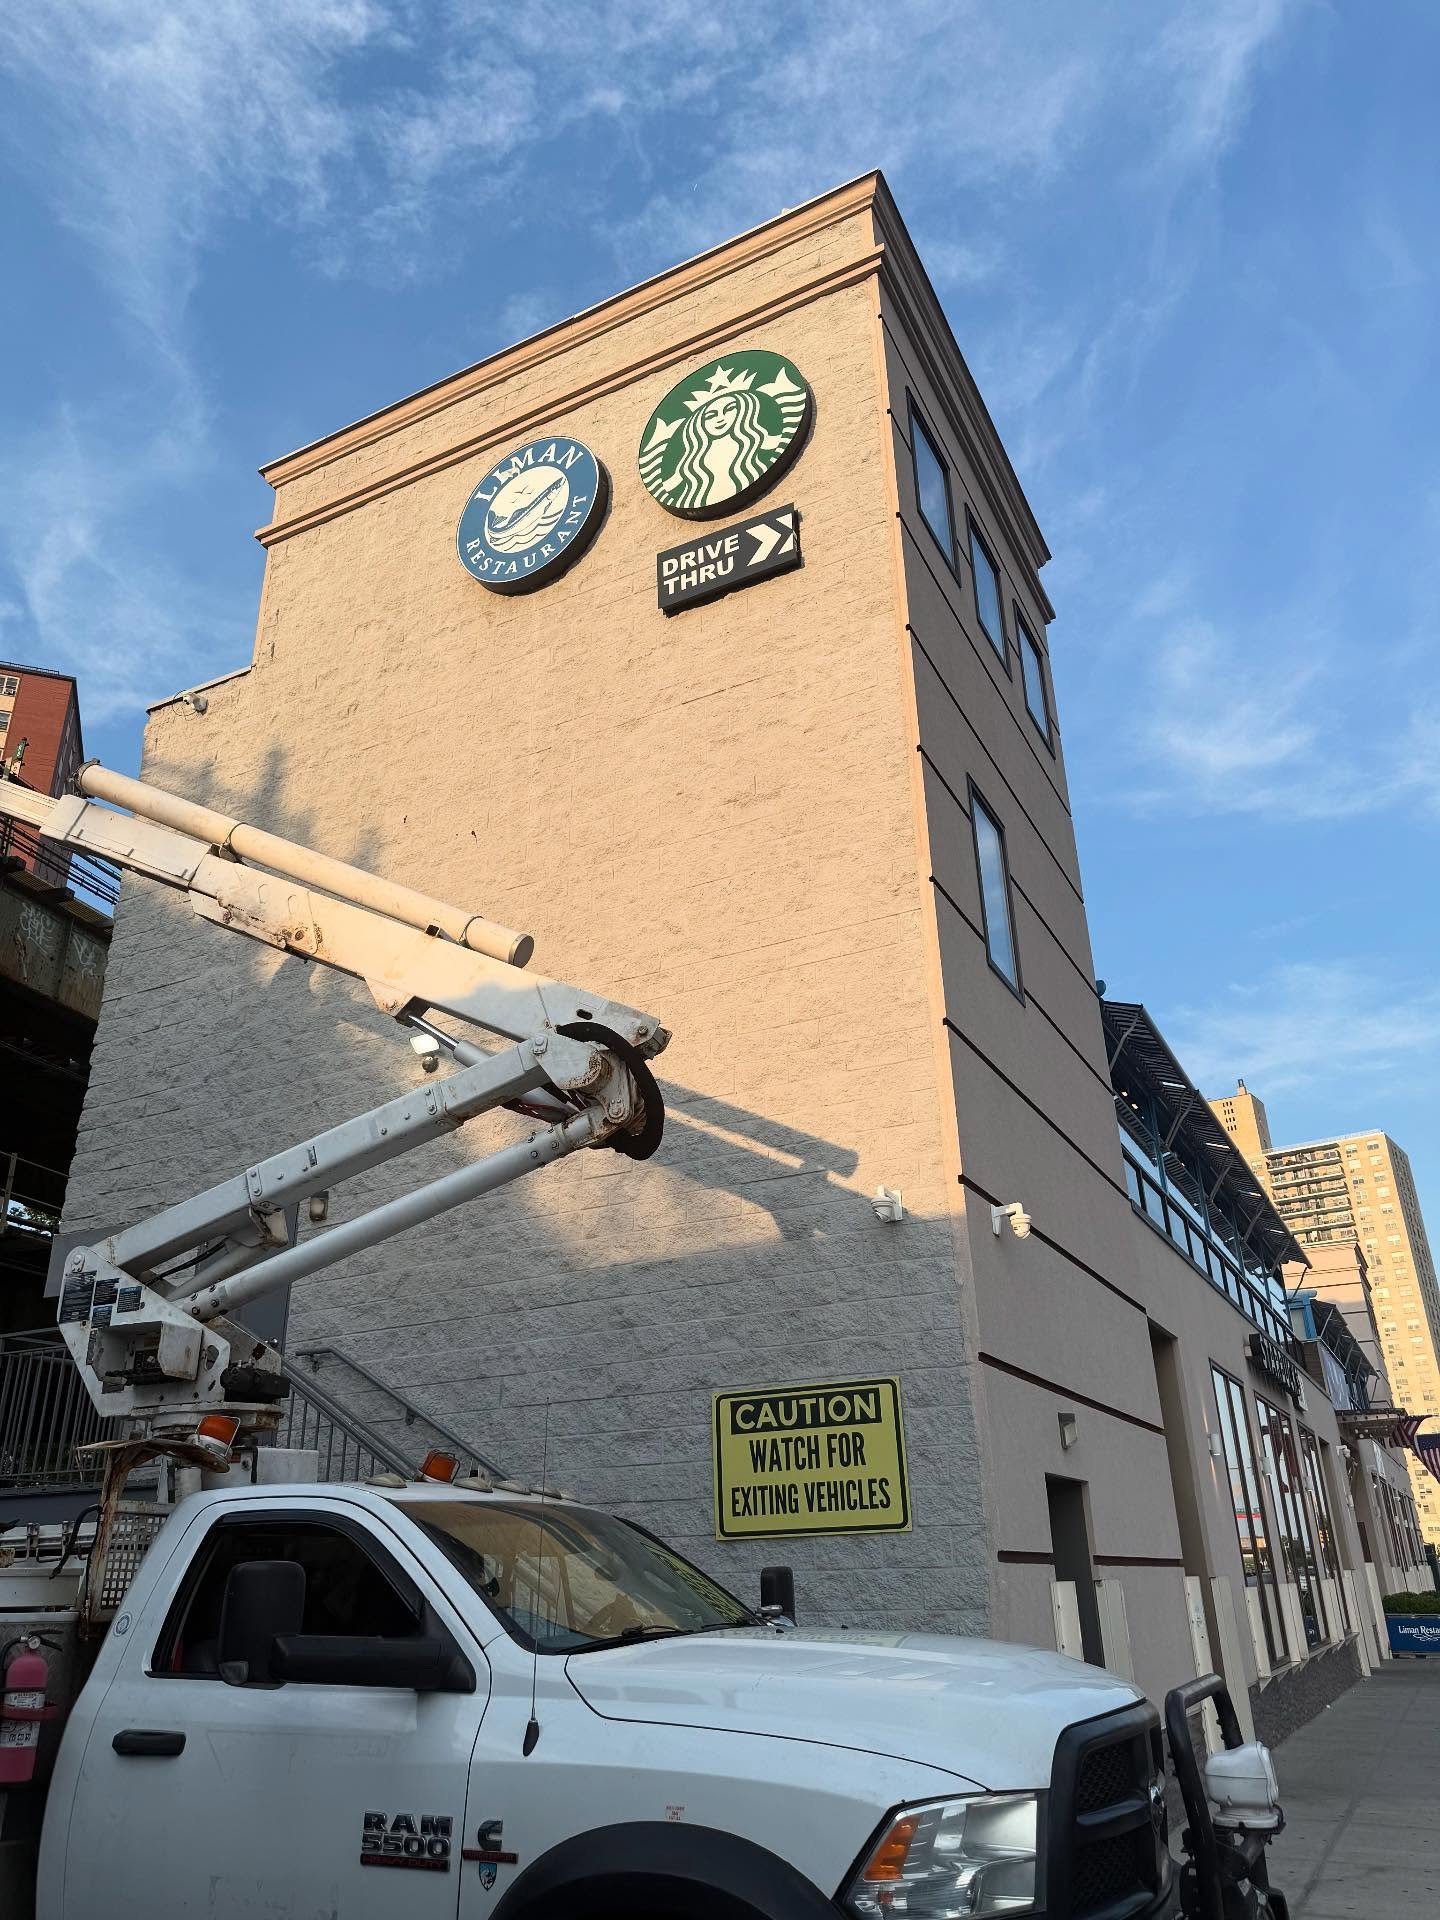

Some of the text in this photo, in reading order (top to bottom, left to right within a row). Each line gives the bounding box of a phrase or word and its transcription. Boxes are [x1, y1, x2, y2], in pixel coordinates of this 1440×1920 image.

[466, 495, 587, 575] RESTAURANT
[662, 533, 740, 577] DRIVE
[663, 556, 734, 595] THRU
[735, 1392, 876, 1430] CAUTION
[749, 1431, 867, 1473] WATCH FOR
[731, 1477, 891, 1517] EXITING VEHICLES
[1398, 1625, 1419, 1634] Liman
[363, 1810, 454, 1836] RAM
[361, 1832, 452, 1858] 5500
